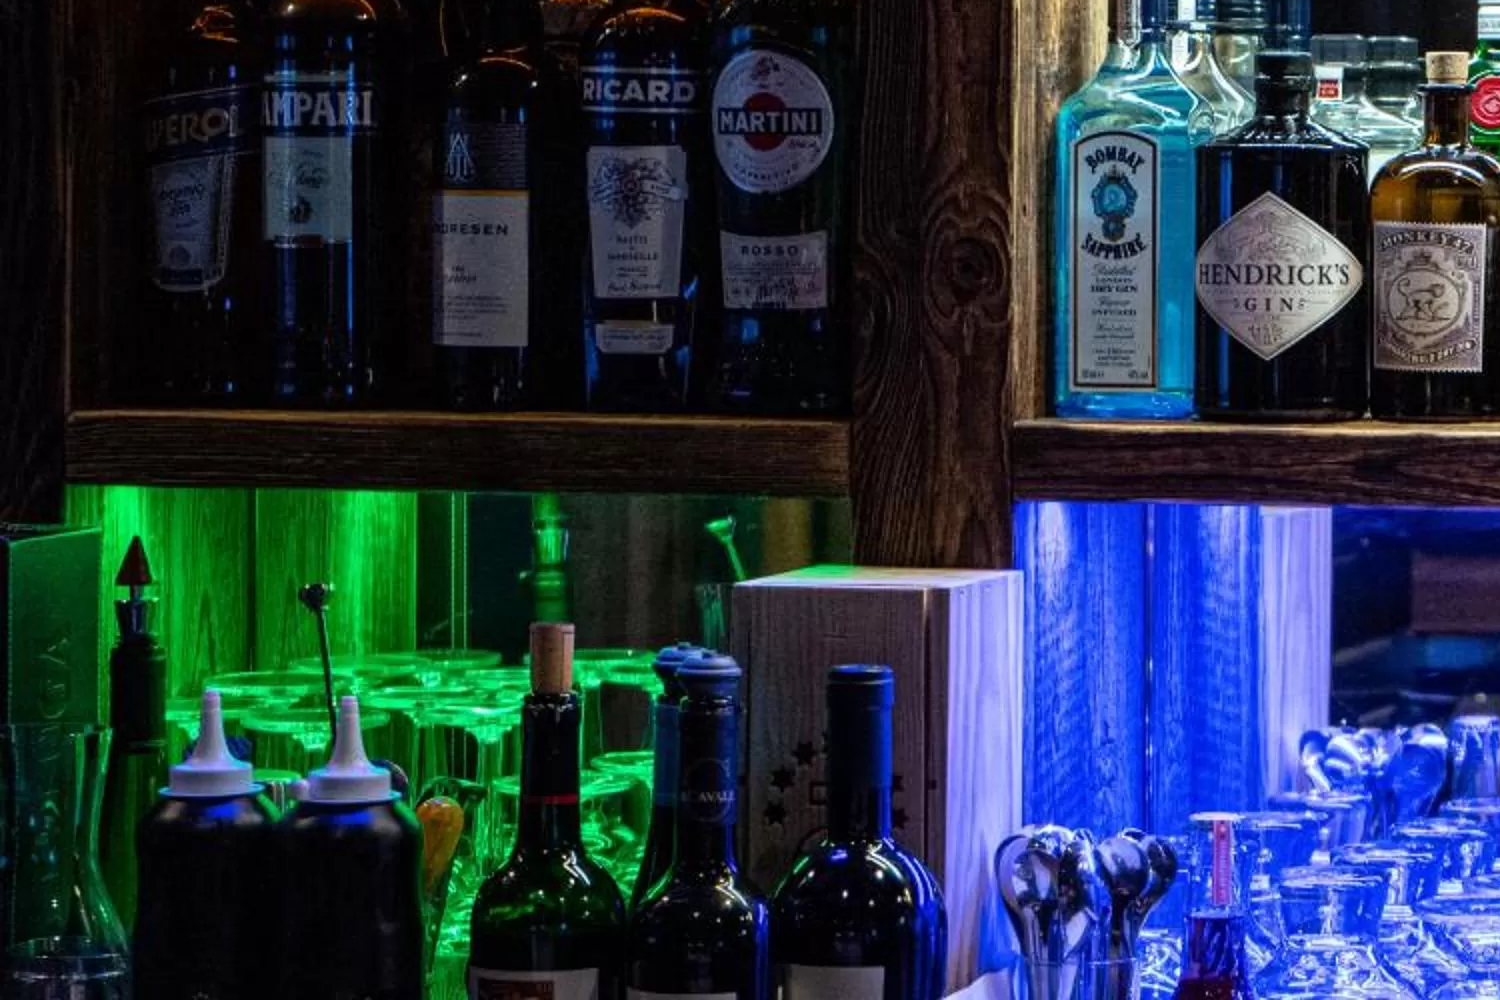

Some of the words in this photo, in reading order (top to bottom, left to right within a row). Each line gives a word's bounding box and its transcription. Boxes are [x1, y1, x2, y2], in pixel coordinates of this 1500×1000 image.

[582, 78, 697, 103] RICARD
[261, 90, 373, 127] AMPARI
[719, 110, 819, 134] MARTINI
[1084, 149, 1146, 176] BOMBAY
[740, 244, 798, 256] ROSSO
[1080, 233, 1149, 261] SAPPHIRE
[1381, 230, 1448, 250] MONKEY
[1199, 263, 1350, 287] HENDRICK'S
[1244, 298, 1293, 312] GIN
